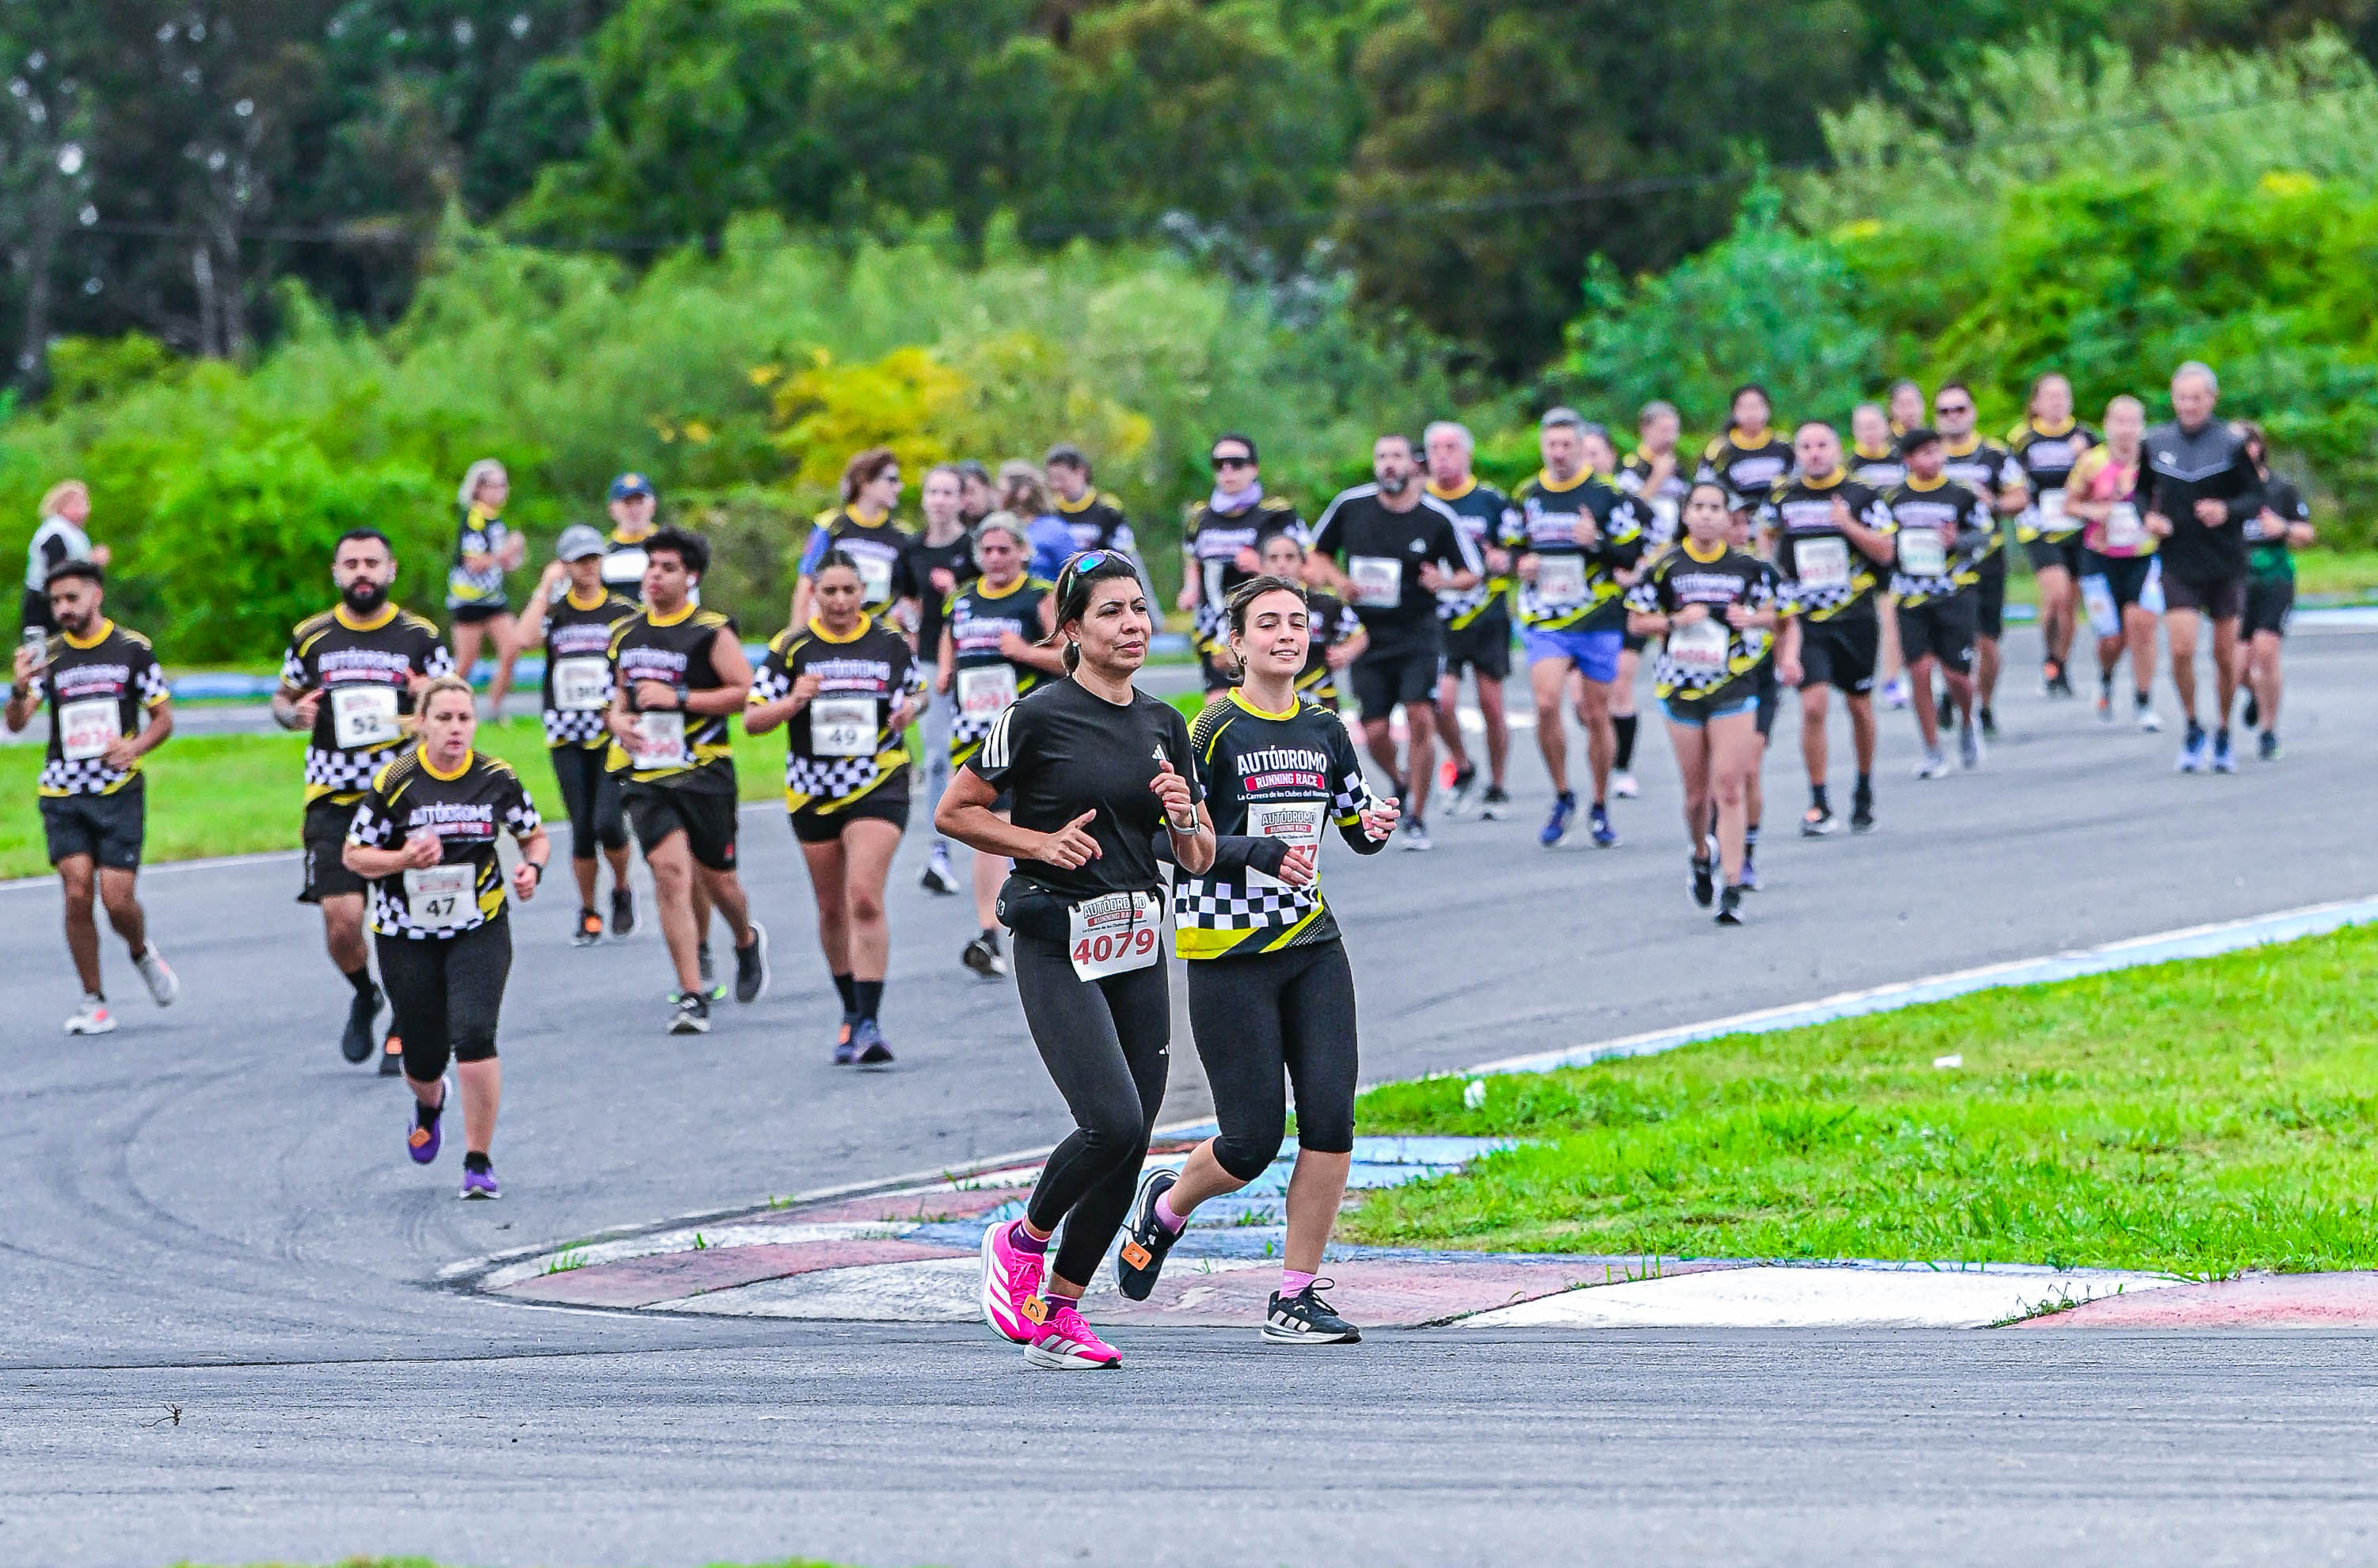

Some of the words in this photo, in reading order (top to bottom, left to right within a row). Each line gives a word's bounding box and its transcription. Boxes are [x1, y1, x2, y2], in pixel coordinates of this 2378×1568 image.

[351, 714, 379, 736] 52
[828, 729, 858, 745] 49
[1237, 744, 1327, 776] AUTÓDROMO
[1254, 772, 1294, 789] RUNNING
[1296, 774, 1318, 786] RACE
[426, 897, 455, 917] 47
[1094, 912, 1120, 924] RUNNING
[1073, 928, 1155, 965] 4079
